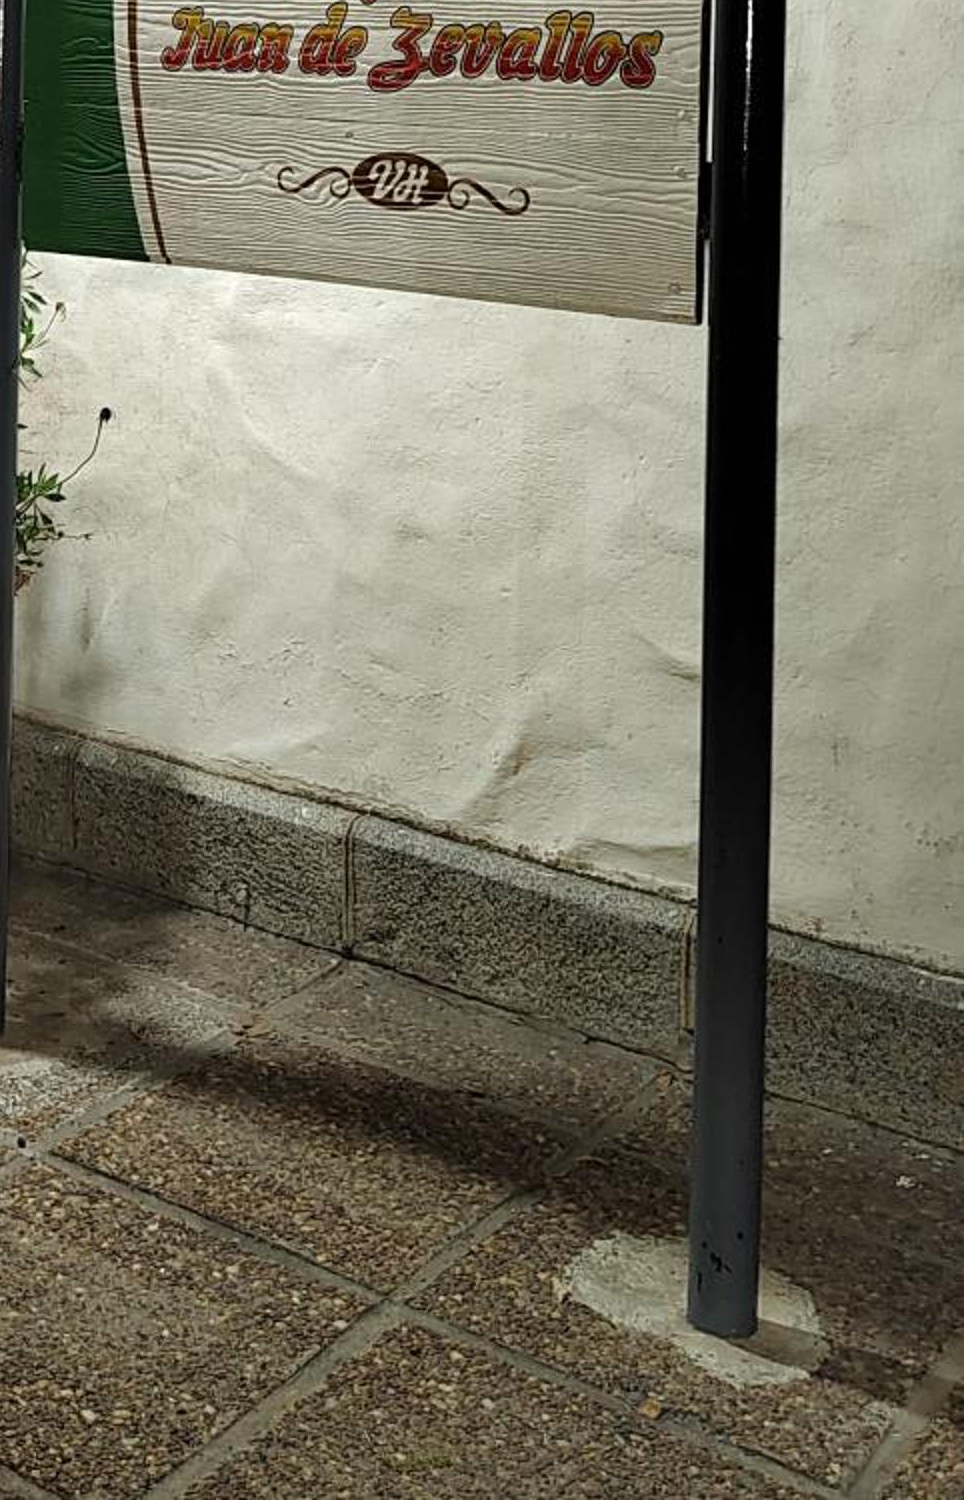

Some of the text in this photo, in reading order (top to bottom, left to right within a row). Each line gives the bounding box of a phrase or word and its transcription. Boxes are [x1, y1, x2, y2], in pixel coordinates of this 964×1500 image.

[160, 0, 665, 93] Juan de Zevallos
